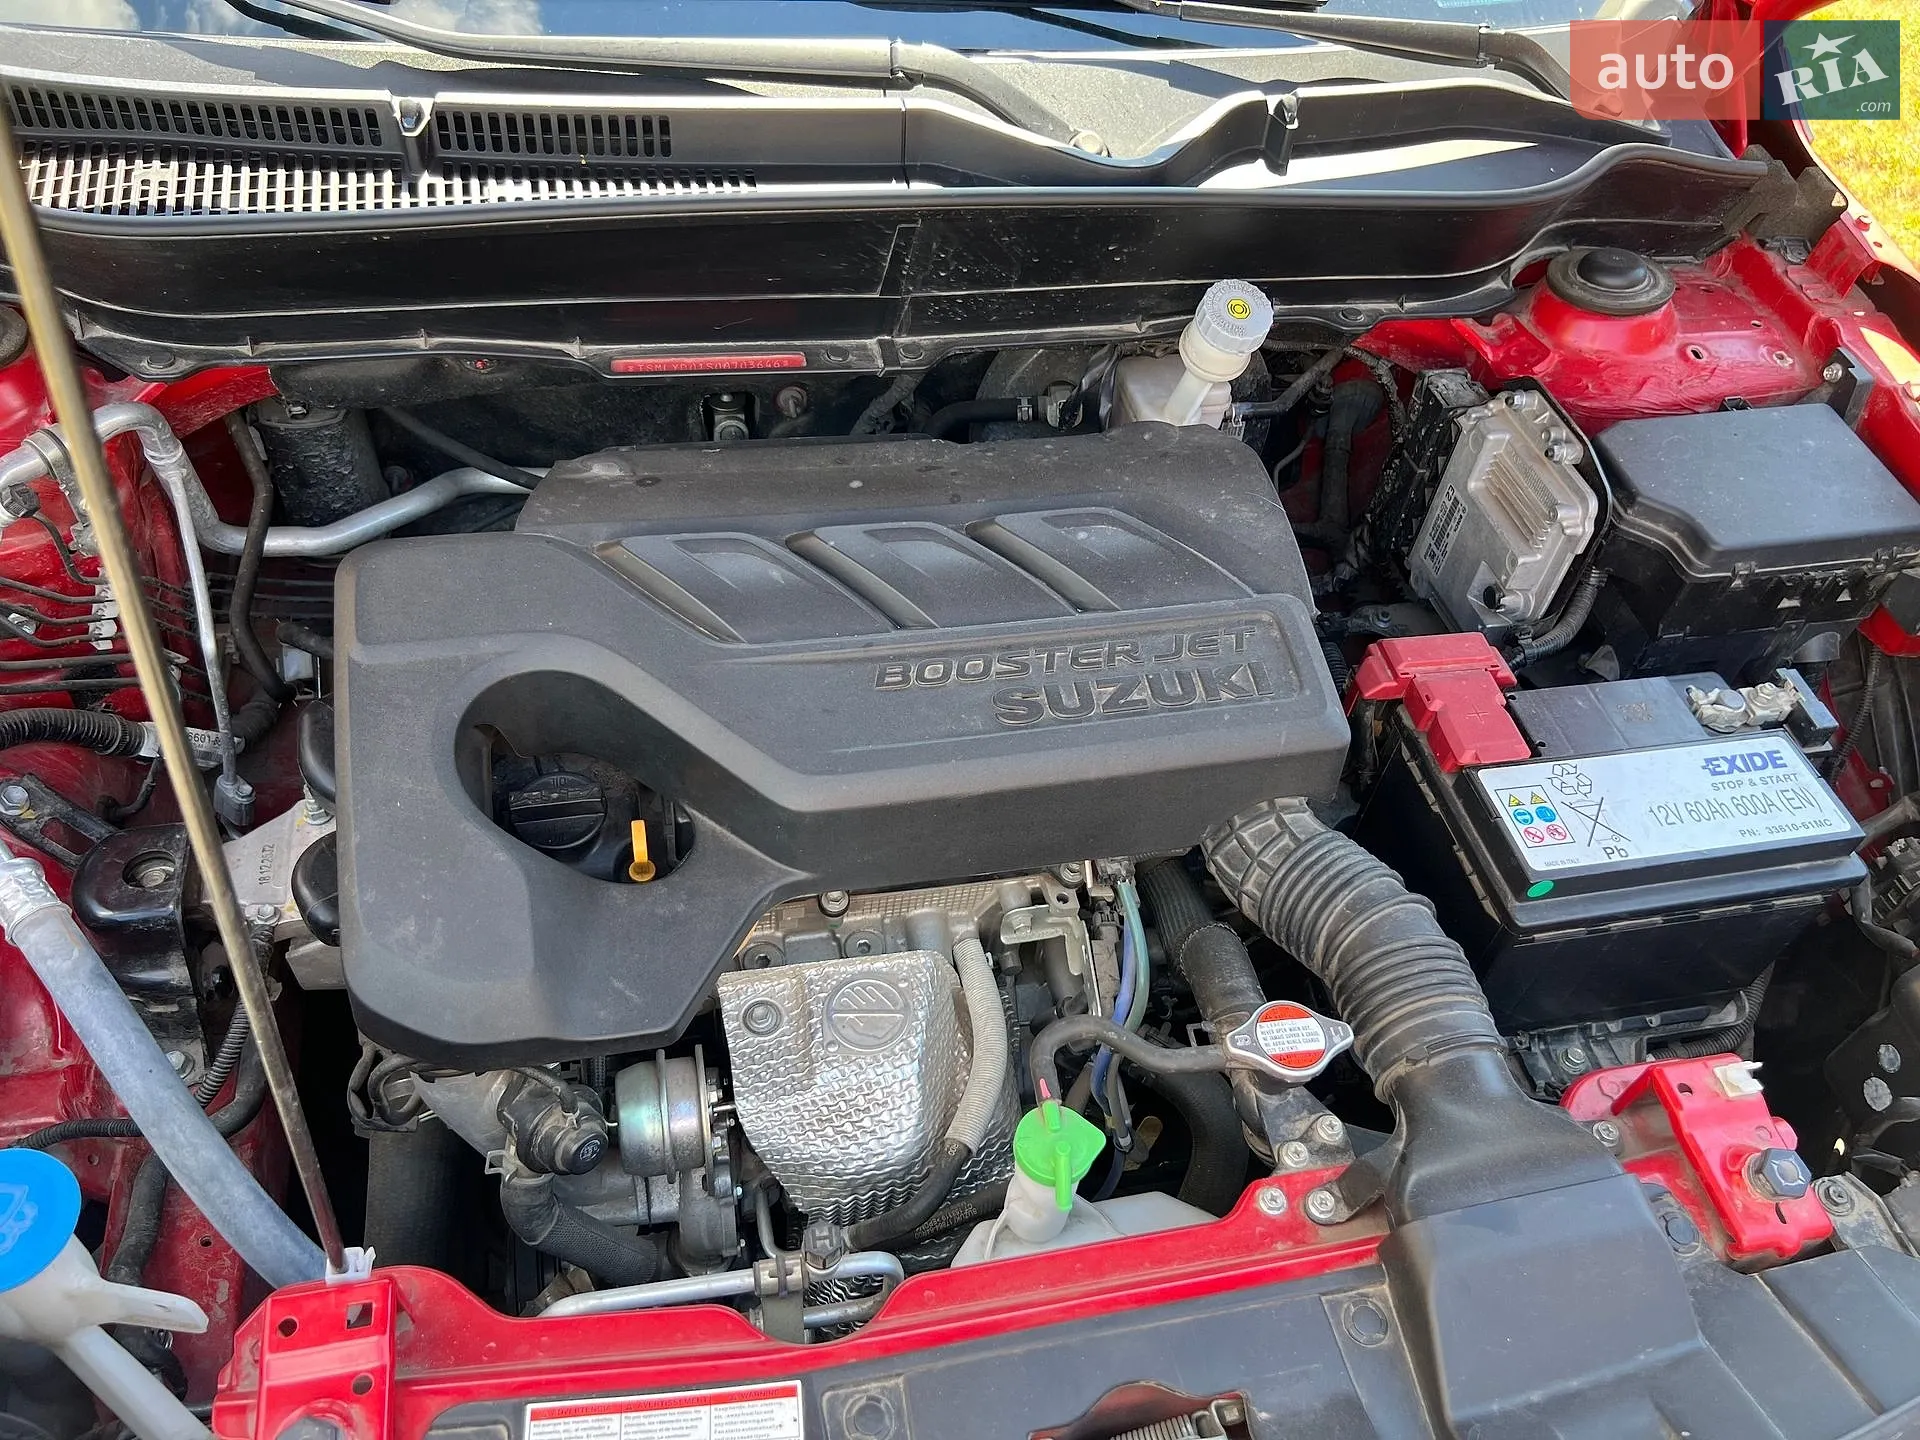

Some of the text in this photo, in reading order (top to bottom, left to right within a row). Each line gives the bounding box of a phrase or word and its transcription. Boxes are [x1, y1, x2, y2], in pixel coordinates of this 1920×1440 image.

[875, 626, 1256, 690] BOOSTER JET
[991, 661, 1275, 727] SUZUKI
[1701, 750, 1788, 776] EXIDE
[1711, 773, 1799, 792] STOP & START
[1649, 787, 1823, 827] 12V 60Ah 600A (EN)
[1739, 827, 1761, 838] PN:
[1602, 845, 1629, 860] Pb
